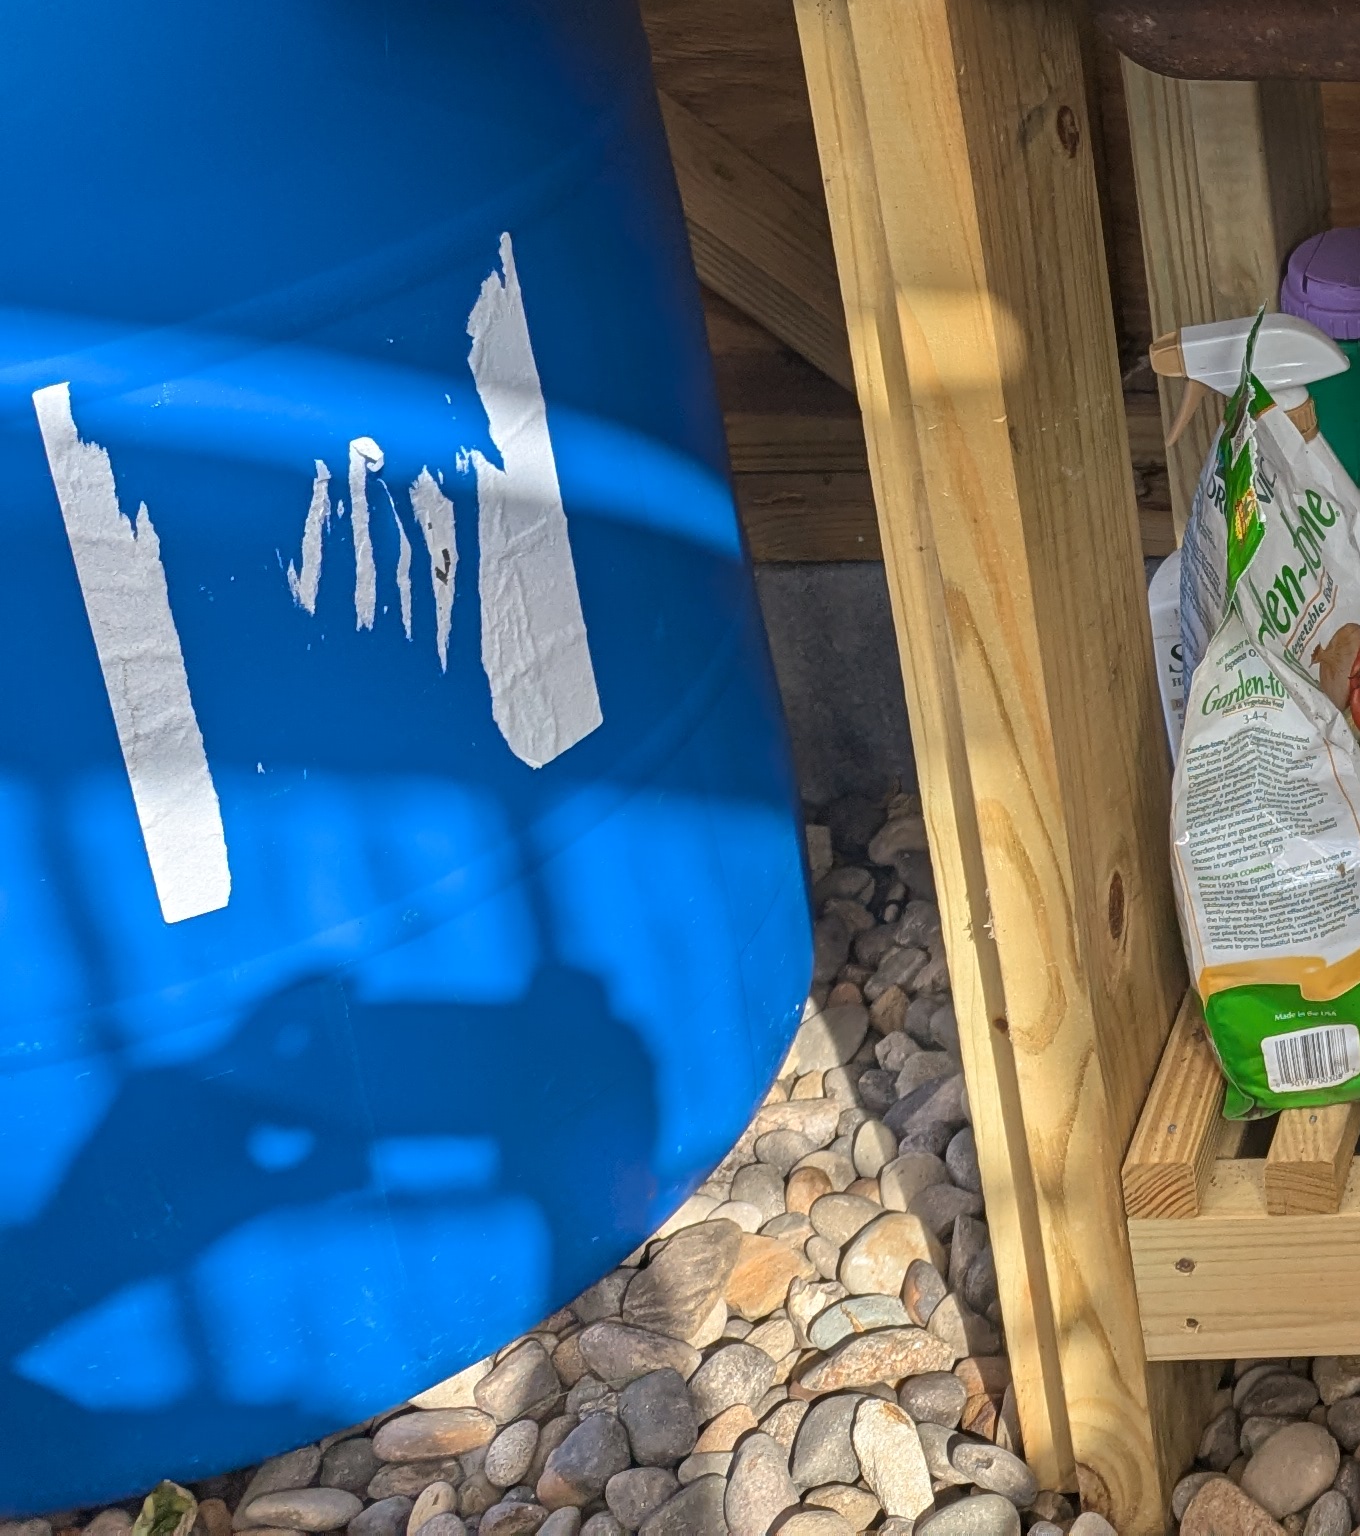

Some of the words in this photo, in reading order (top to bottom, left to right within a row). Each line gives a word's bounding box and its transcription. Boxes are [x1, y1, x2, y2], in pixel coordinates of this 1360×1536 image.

[1224, 652, 1247, 673] Espoma
[1242, 711, 1268, 724] 3-4-4
[1222, 872, 1239, 880] OUR
[1249, 872, 1276, 885] Espoma
[1276, 862, 1310, 877] Company
[1274, 1011, 1296, 1022] Made
